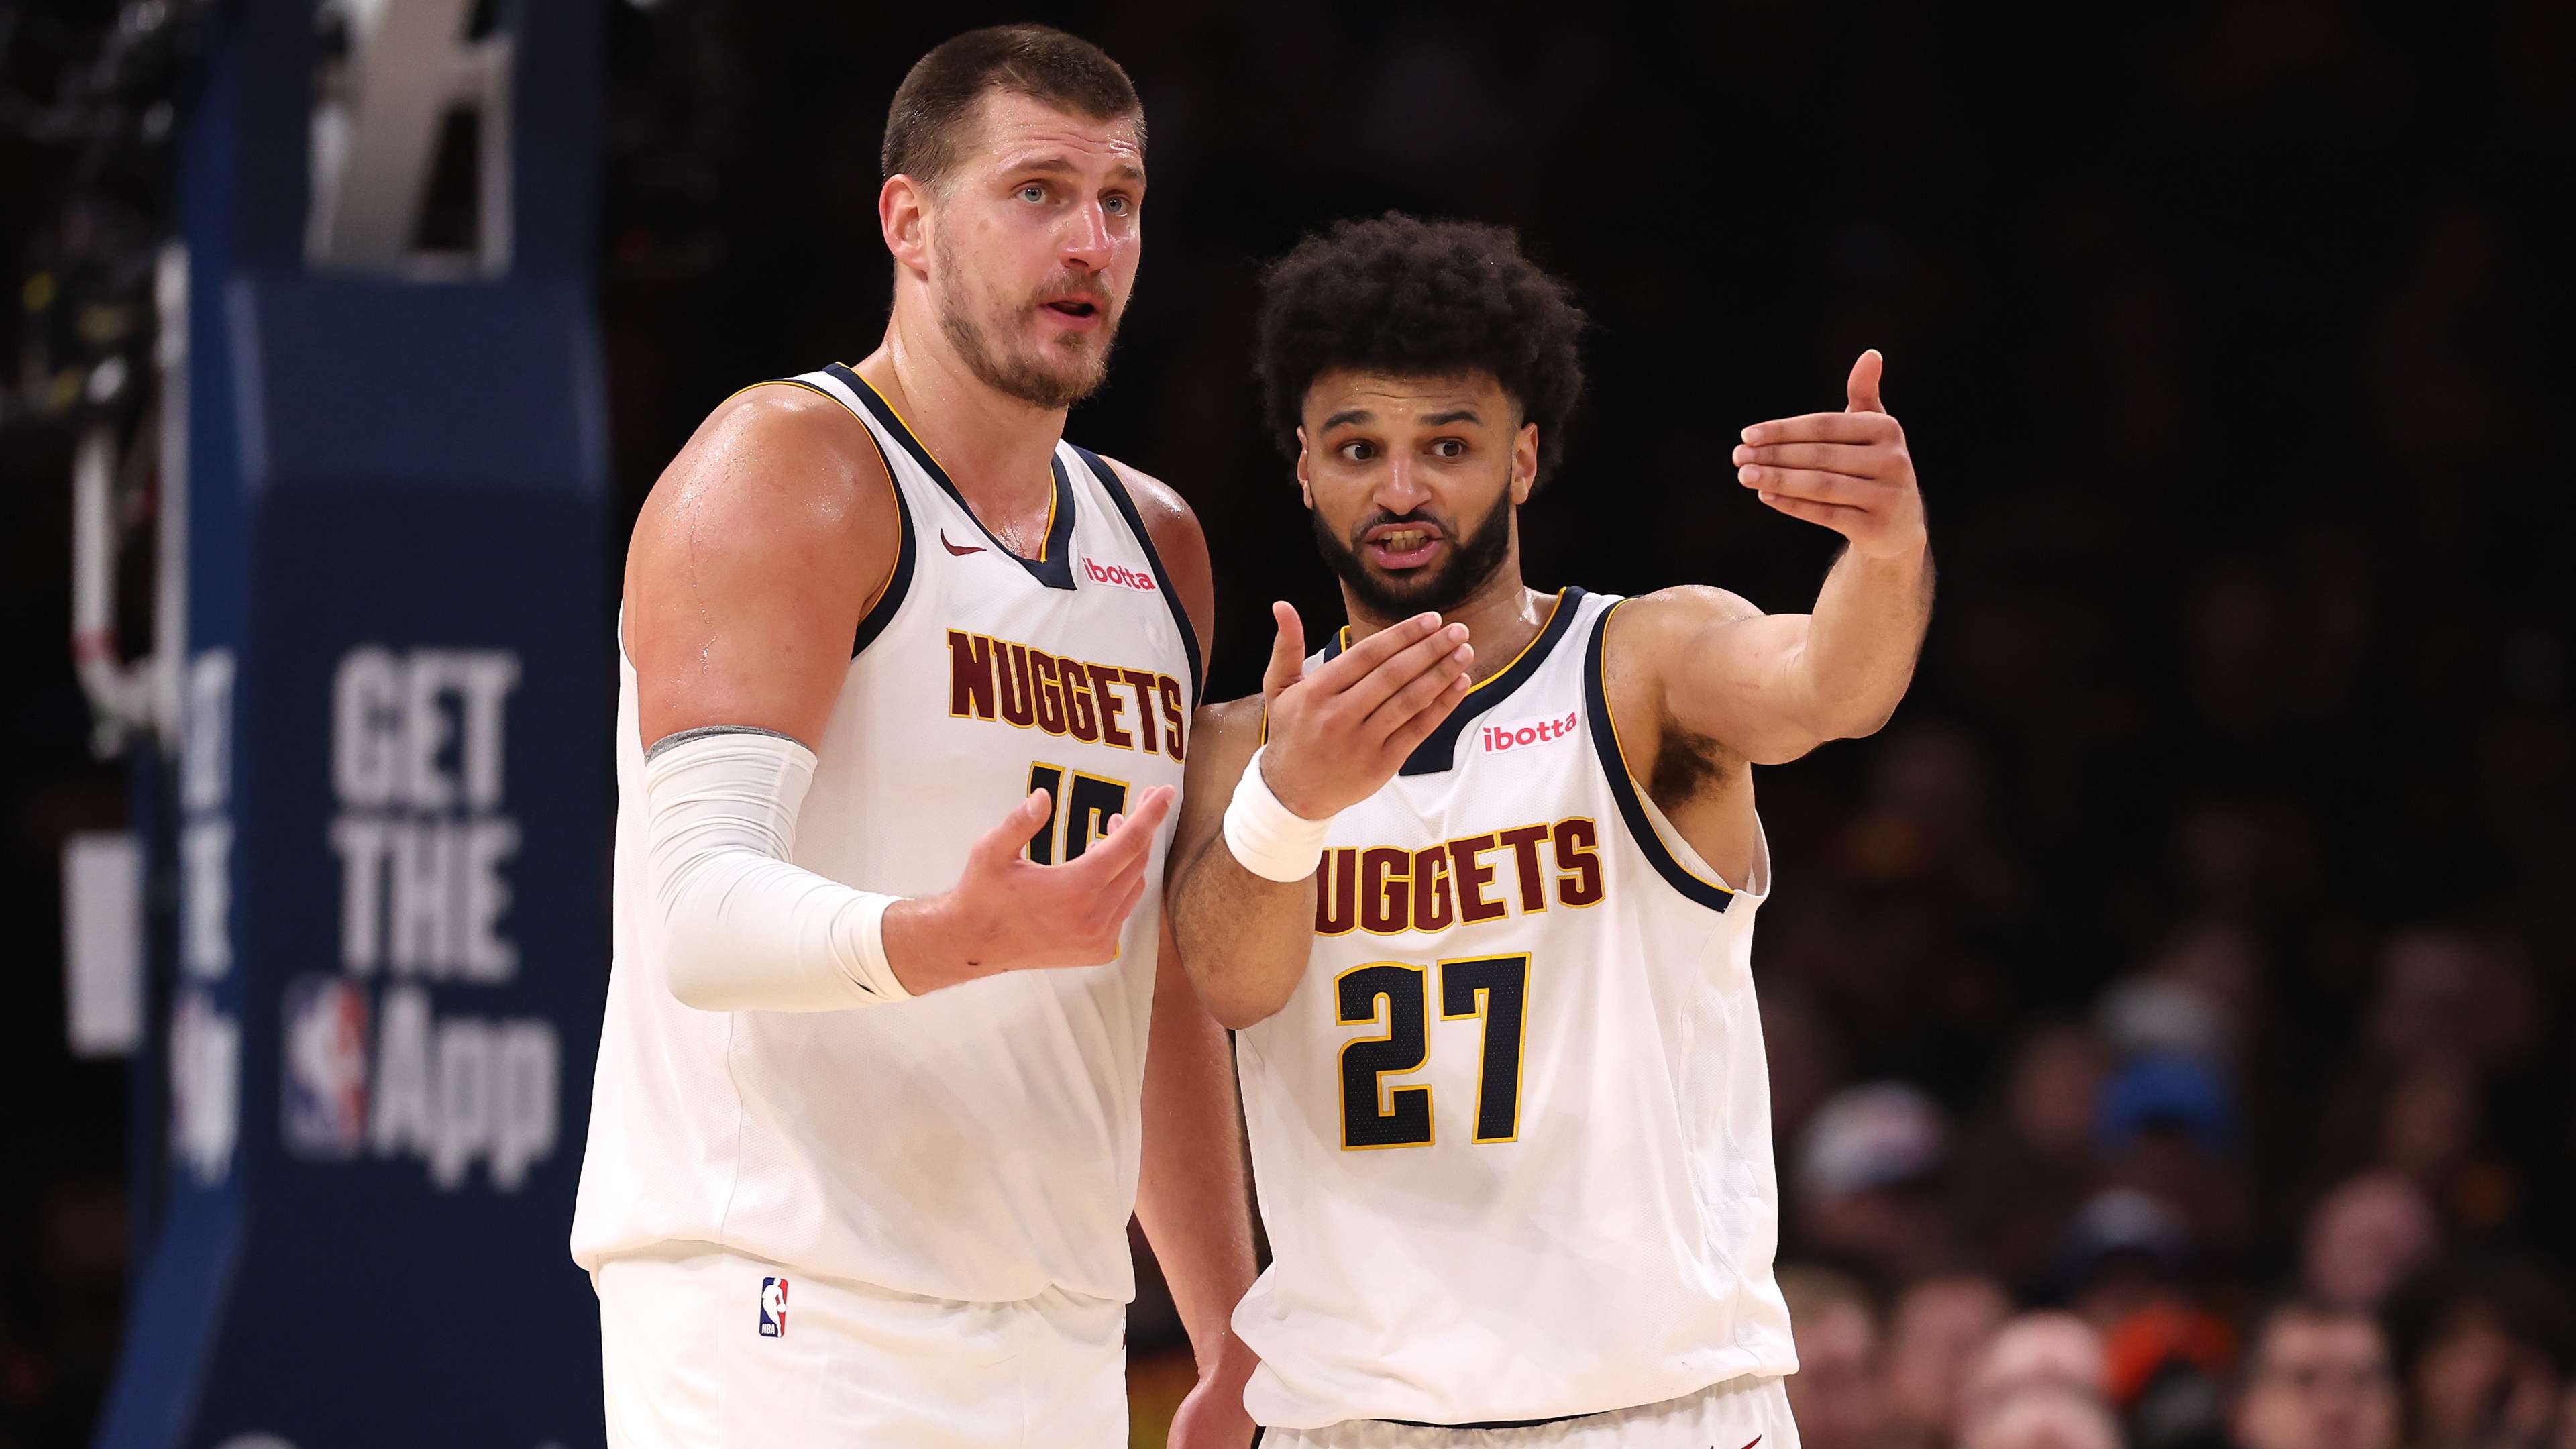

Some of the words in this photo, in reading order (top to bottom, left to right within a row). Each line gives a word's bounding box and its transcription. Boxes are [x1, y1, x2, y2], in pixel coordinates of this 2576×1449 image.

[1081, 557, 1156, 590] ibotta
[333, 647, 521, 805] GET
[947, 627, 1184, 763] NUGGETS
[1483, 711, 1577, 752] ibotta
[329, 818, 521, 981] THE
[1315, 816, 1606, 937] UGGETS
[371, 983, 561, 1190] App
[1334, 951, 1532, 1152] 27
[761, 1323, 775, 1334] NBA
